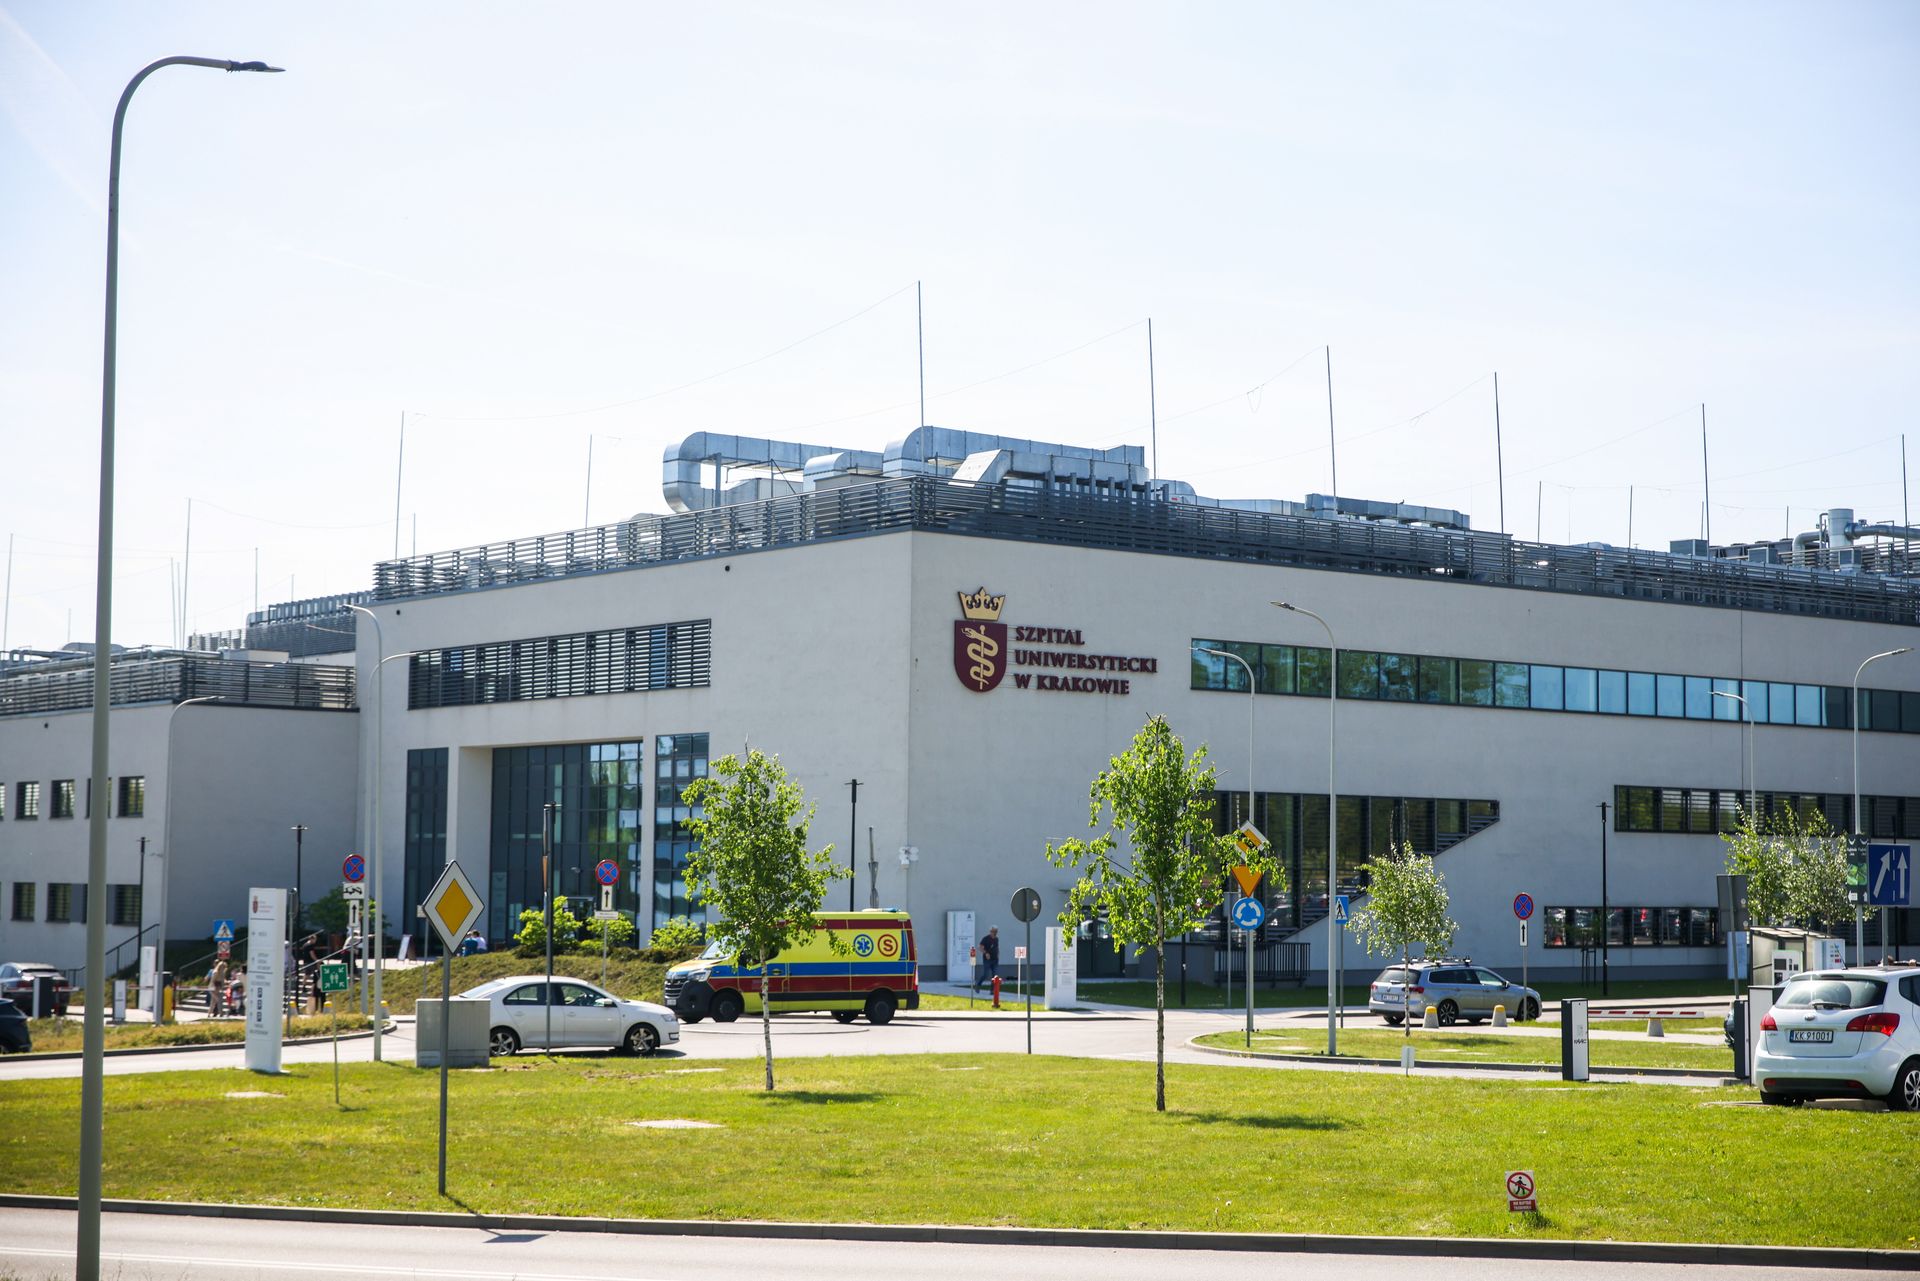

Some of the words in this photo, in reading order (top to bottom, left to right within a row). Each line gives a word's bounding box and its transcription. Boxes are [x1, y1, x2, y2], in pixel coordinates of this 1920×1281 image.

[1016, 626, 1085, 645] SZPITAL
[1014, 649, 1158, 673] UNIWERSYTECKI
[1014, 673, 1032, 689] W
[1036, 674, 1129, 694] KRAKOWIE
[883, 939, 894, 952] S
[1794, 1031, 1805, 1041] KK
[1806, 1031, 1830, 1041] 91001
